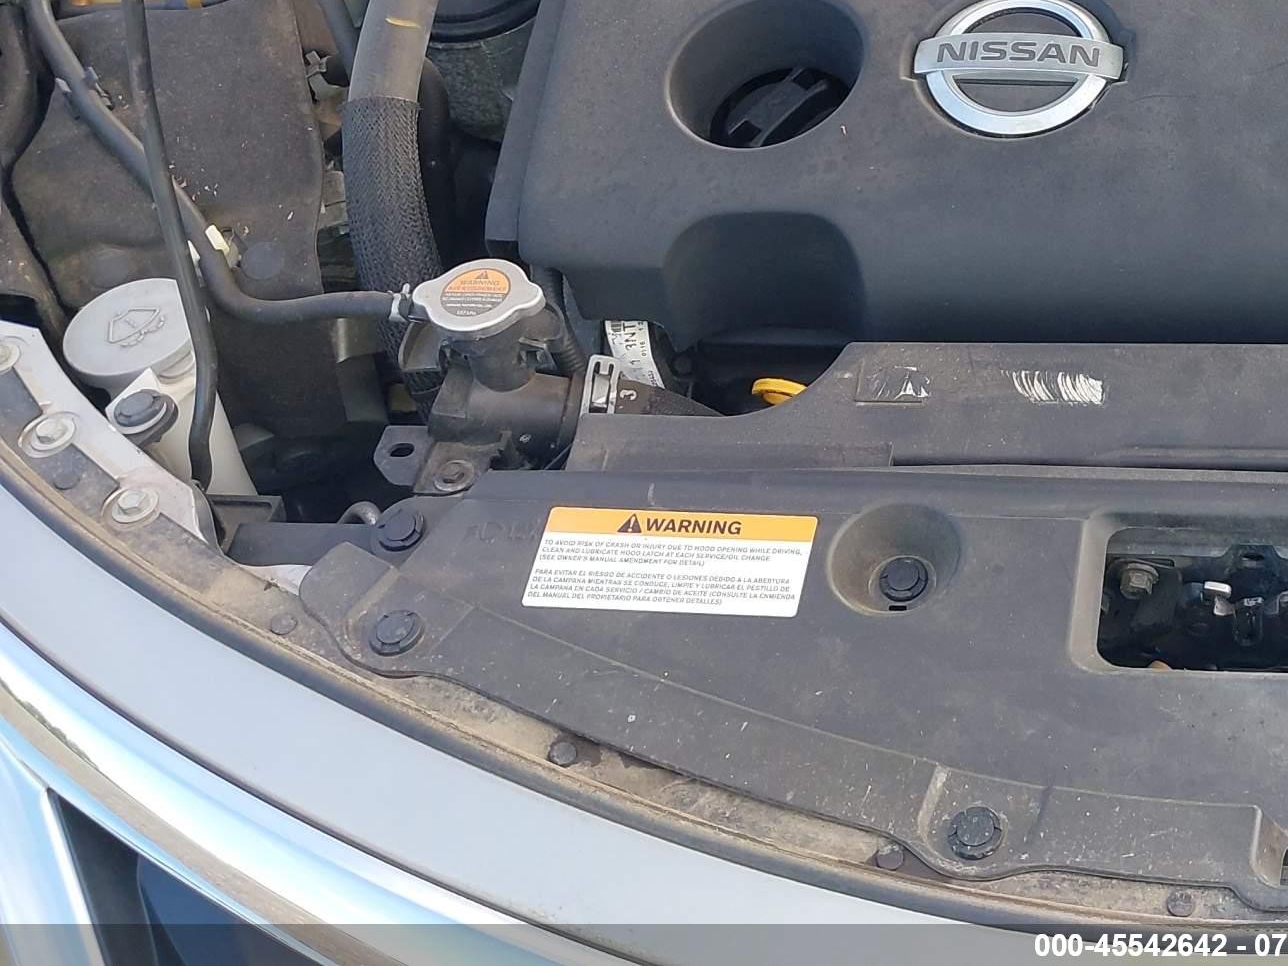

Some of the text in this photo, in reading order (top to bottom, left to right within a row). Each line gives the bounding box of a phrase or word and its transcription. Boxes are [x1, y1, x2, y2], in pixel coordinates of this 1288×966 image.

[937, 40, 1099, 67] NISSAN
[620, 389, 637, 401] 3
[646, 518, 742, 535] WARNING
